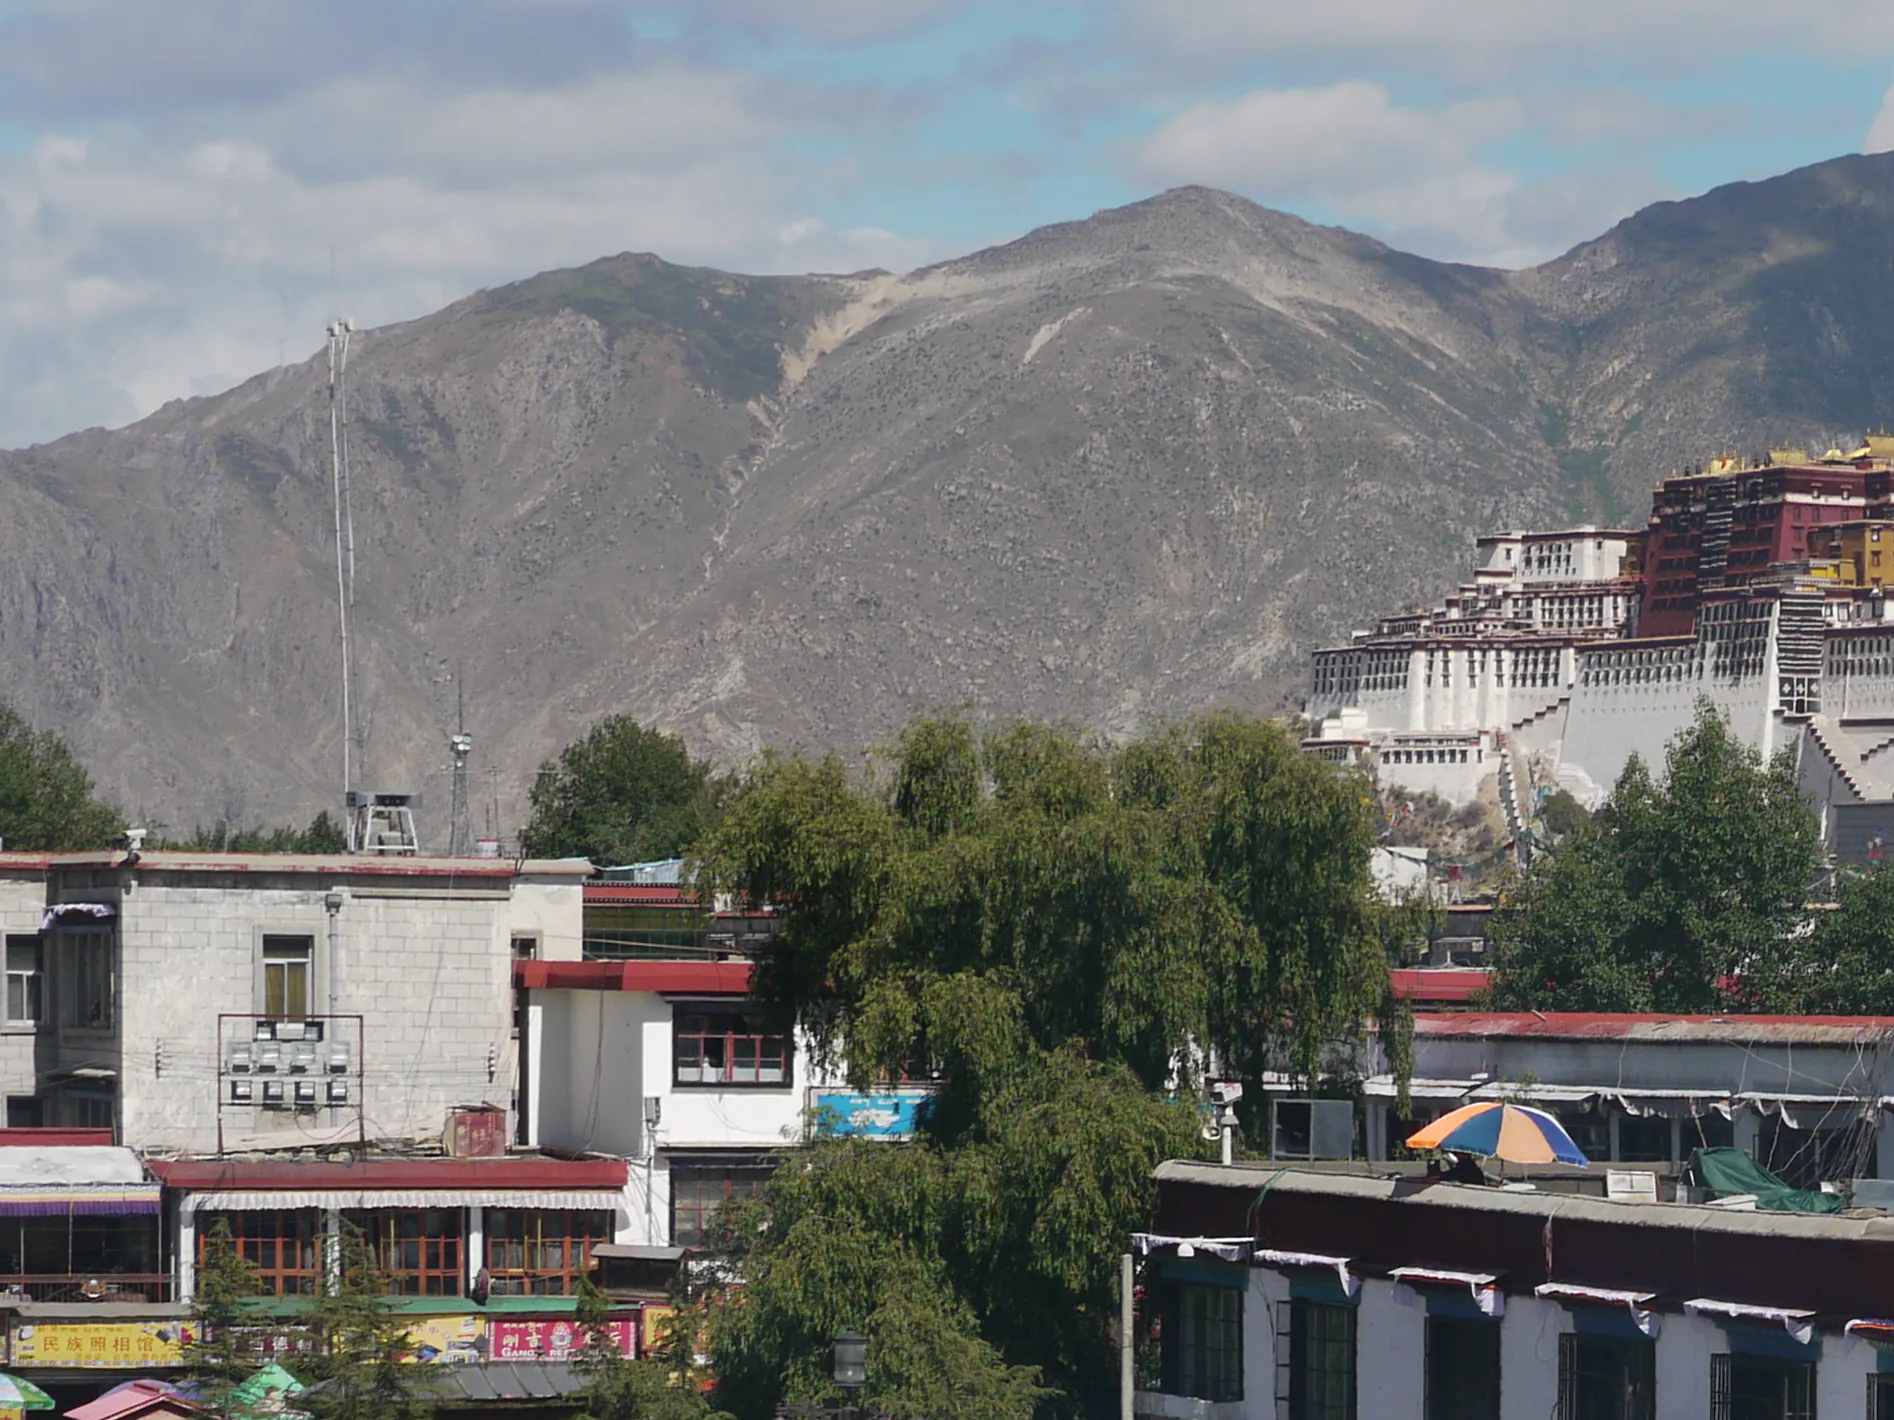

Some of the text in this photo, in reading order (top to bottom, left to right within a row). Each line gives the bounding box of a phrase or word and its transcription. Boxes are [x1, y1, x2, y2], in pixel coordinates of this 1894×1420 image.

[43, 1336, 155, 1352] 民族照相馆
